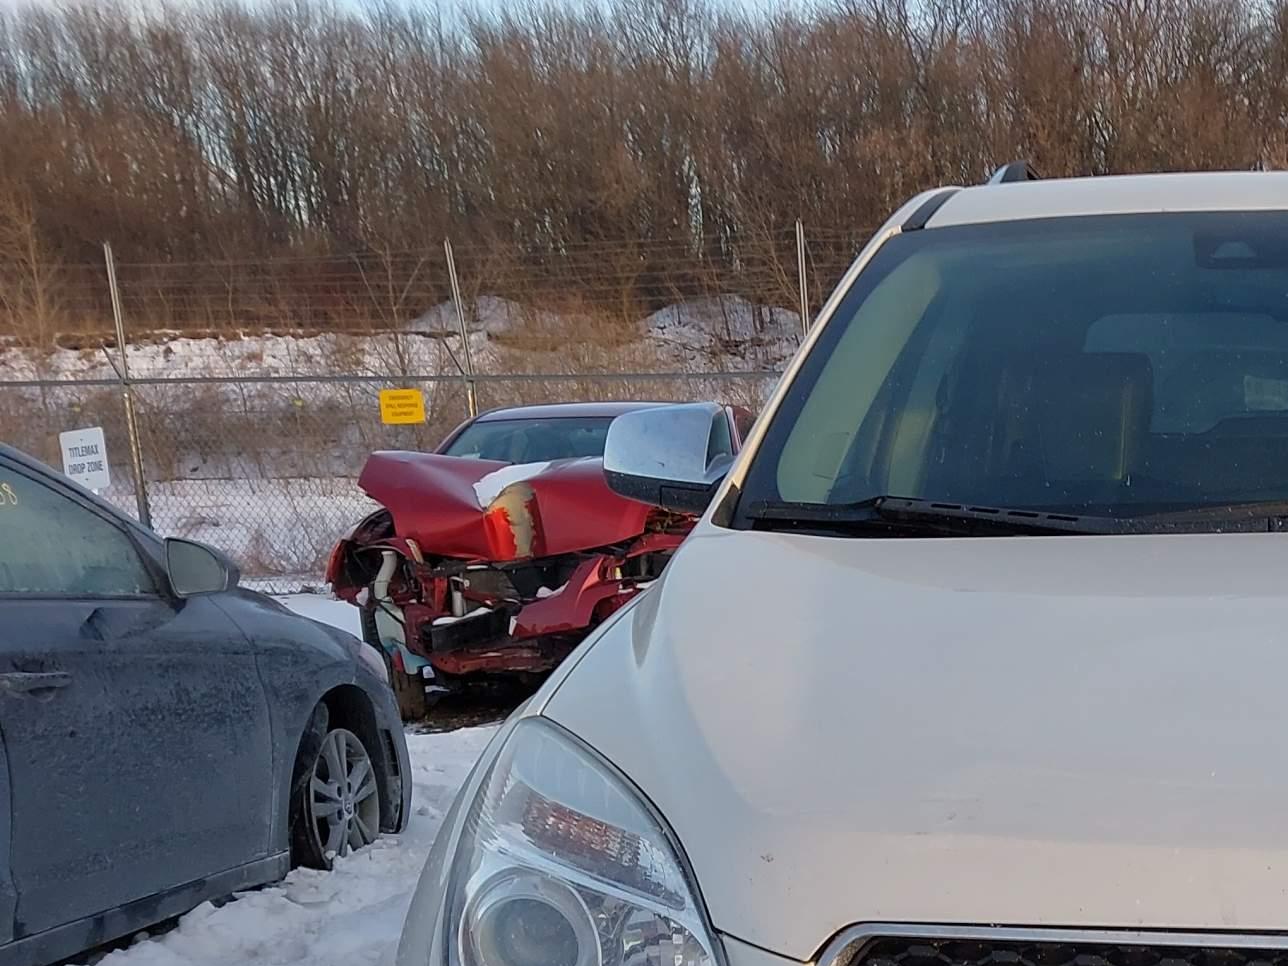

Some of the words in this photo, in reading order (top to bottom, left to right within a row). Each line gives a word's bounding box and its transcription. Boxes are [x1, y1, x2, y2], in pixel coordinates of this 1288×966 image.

[68, 444, 99, 458] TITLEMAX
[68, 462, 86, 475] DROP
[87, 460, 104, 473] ZONE
